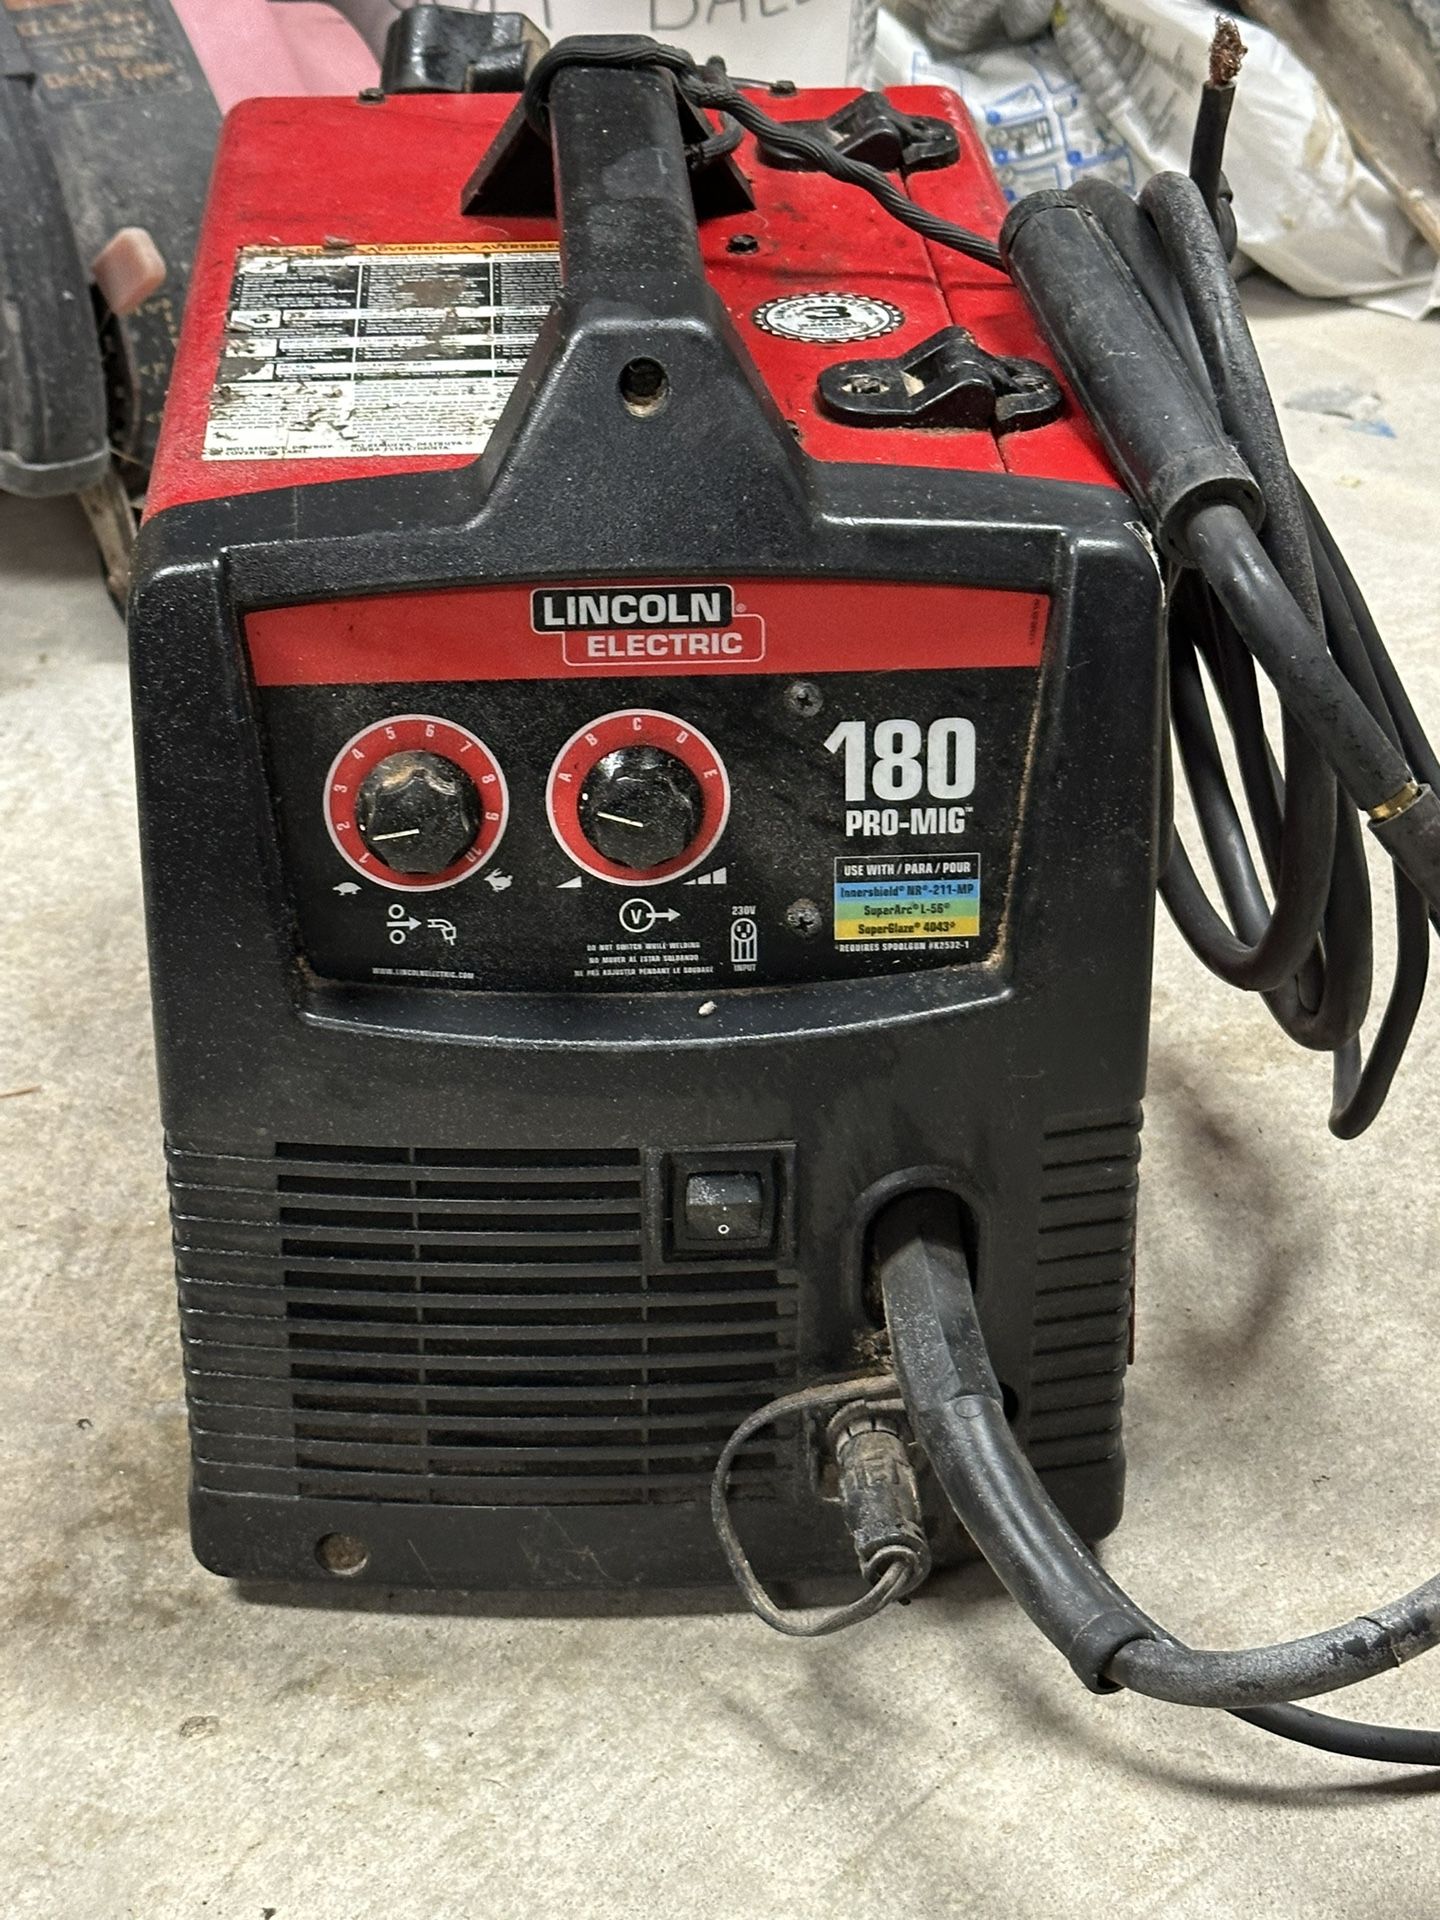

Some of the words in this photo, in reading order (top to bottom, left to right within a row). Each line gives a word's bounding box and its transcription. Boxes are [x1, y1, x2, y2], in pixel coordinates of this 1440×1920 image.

[803, 305, 852, 320] 3
[543, 592, 721, 626] LINCOLN
[586, 632, 743, 658] ELECTRIC
[385, 726, 396, 740] 5
[425, 724, 435, 738] 6
[459, 740, 473, 753] 7
[557, 771, 573, 783] A
[584, 732, 599, 747] B
[632, 717, 643, 732] C
[675, 730, 689, 744] D
[703, 768, 718, 779] E
[351, 748, 366, 761] 4
[823, 717, 976, 802] 180
[481, 773, 497, 785] 8
[333, 783, 348, 794] 3
[485, 811, 500, 822] 9
[336, 820, 351, 832] 2
[359, 852, 371, 864] 1
[844, 864, 864, 876] USE
[866, 863, 895, 876] WITH
[904, 862, 933, 874] PARA
[943, 861, 971, 873] POUR
[732, 905, 756, 916] 230V
